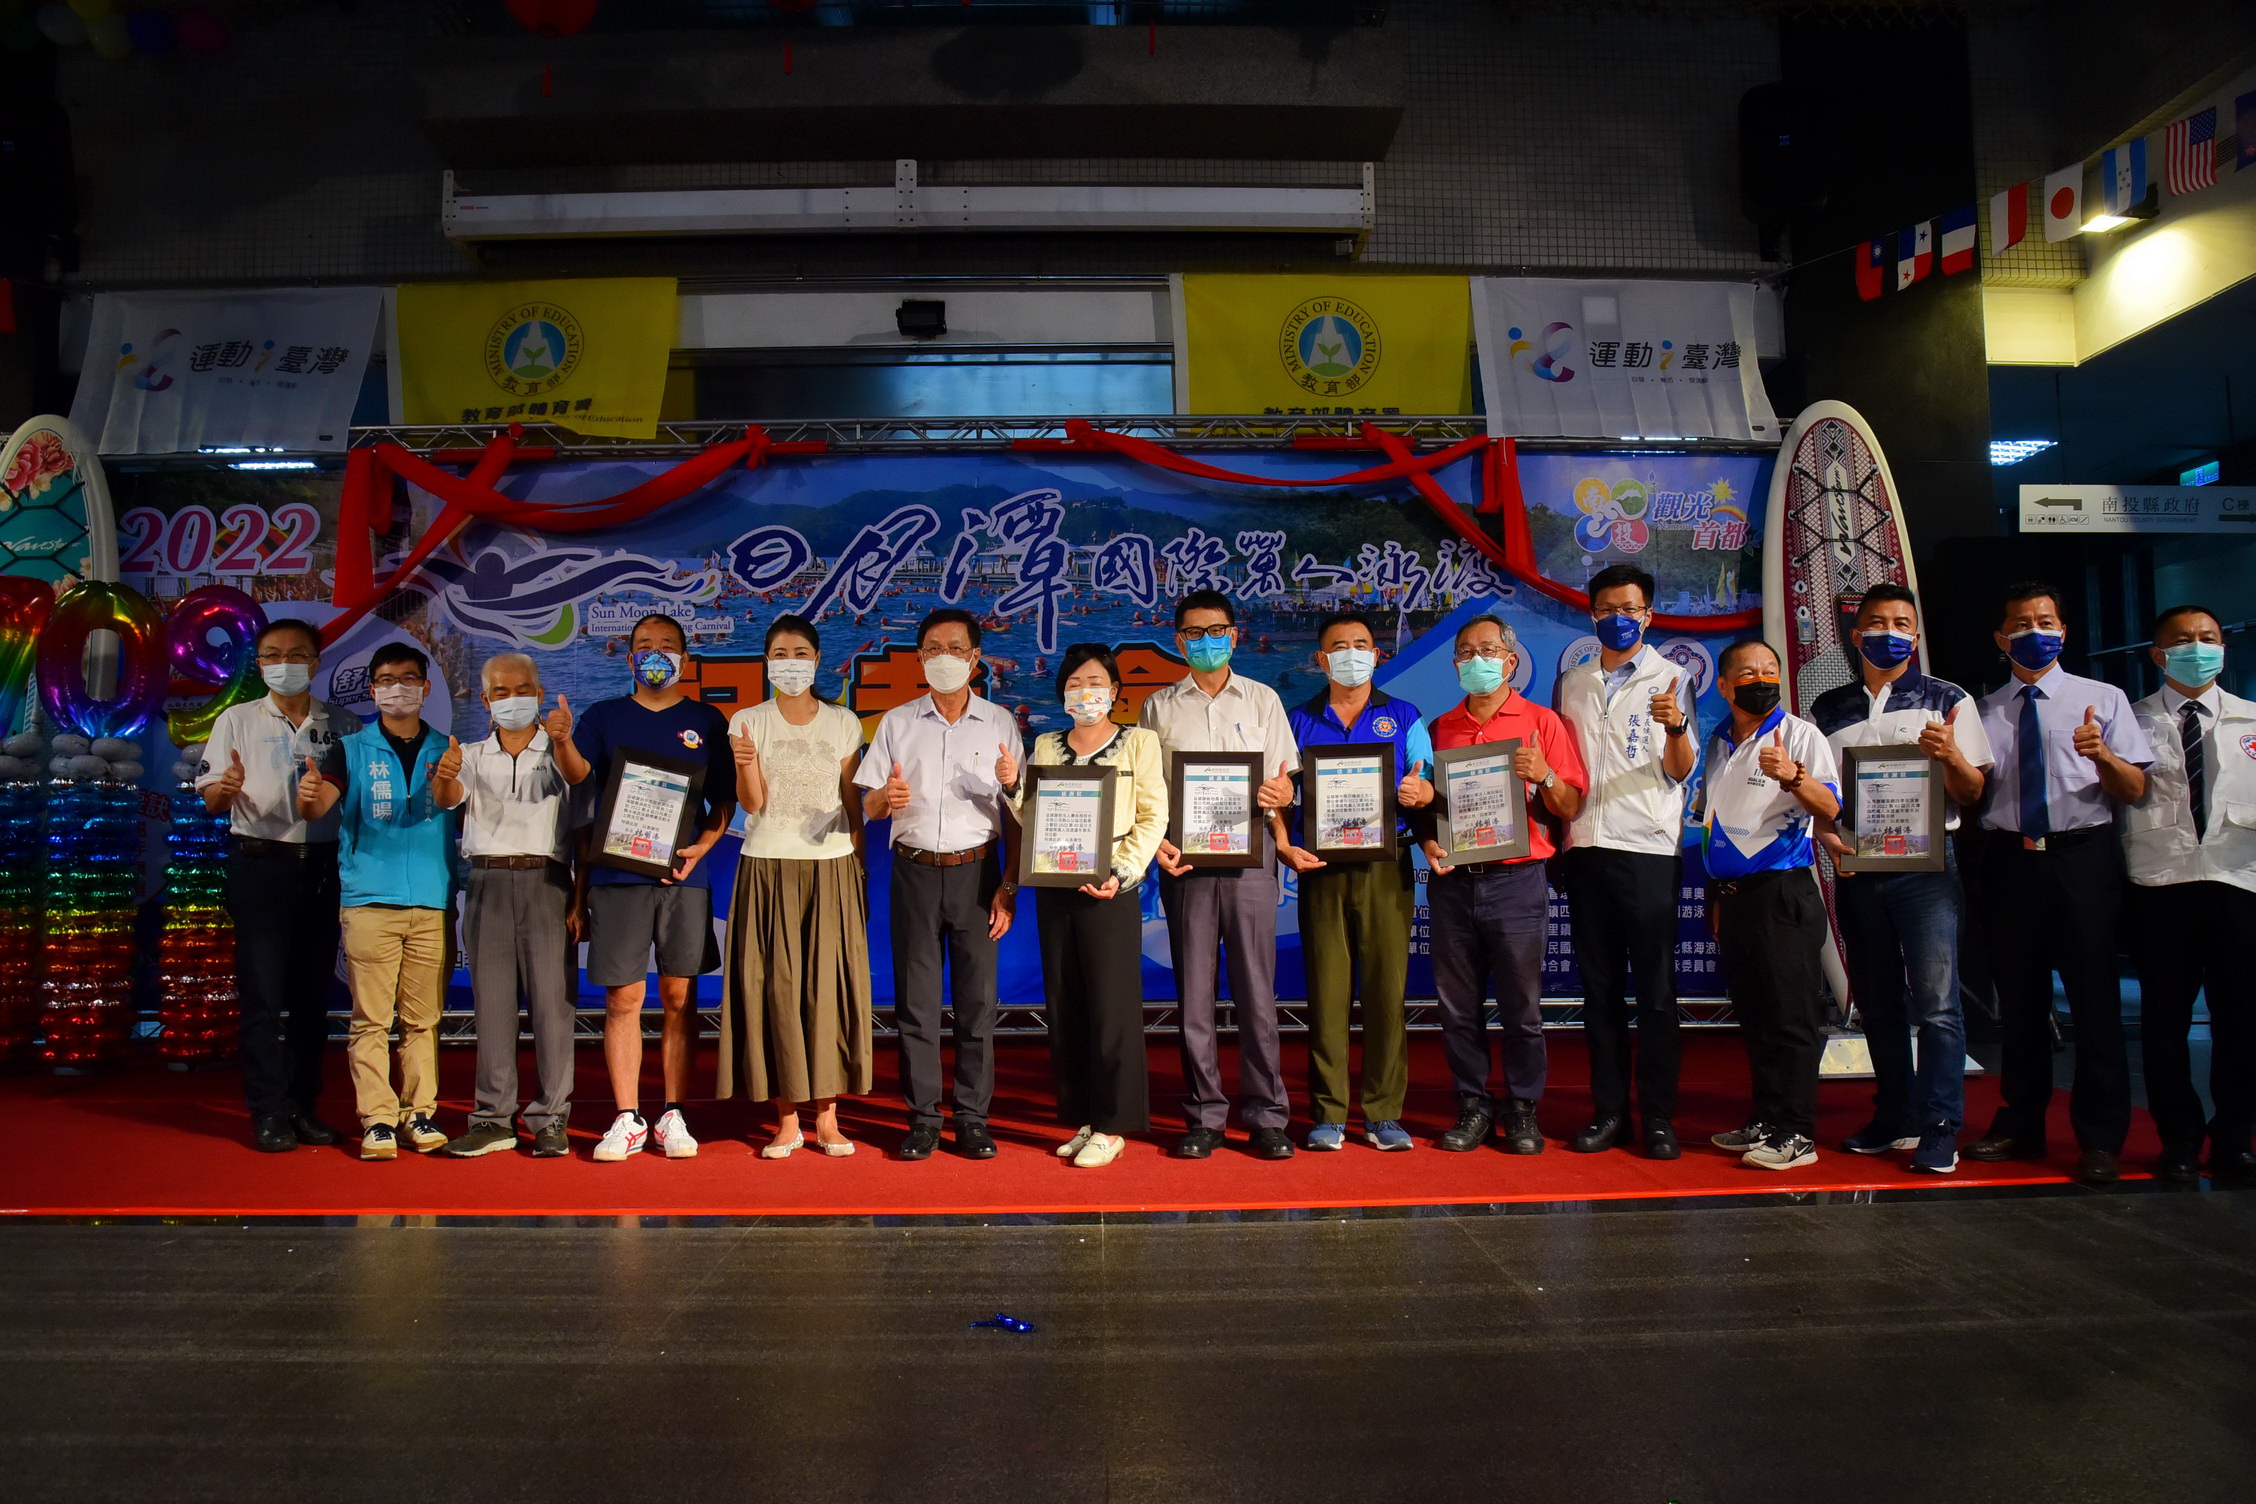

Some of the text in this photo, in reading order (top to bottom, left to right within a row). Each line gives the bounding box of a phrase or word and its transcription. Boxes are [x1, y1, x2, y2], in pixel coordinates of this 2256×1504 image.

[485, 306, 580, 377] MINISTRY OF EDUCATION
[1284, 300, 1376, 375] MINISTRY OF EDUCATION
[502, 374, 561, 395] 教育部
[1300, 373, 1361, 395] 教育部
[1652, 491, 1716, 522] 觀光
[2102, 497, 2200, 513] 南投縣政府
[120, 502, 321, 575] 2022
[1692, 519, 1750, 550] 首都
[591, 604, 692, 619] Sun Moon Lake
[591, 623, 634, 633] Internatio
[695, 620, 731, 632] Carnival
[310, 729, 338, 745] 8.65
[1626, 714, 1640, 758] 張嘉哲
[369, 761, 393, 820] 林儒暘
[1548, 923, 1571, 937] 里鎮
[1409, 942, 1430, 955] 單位
